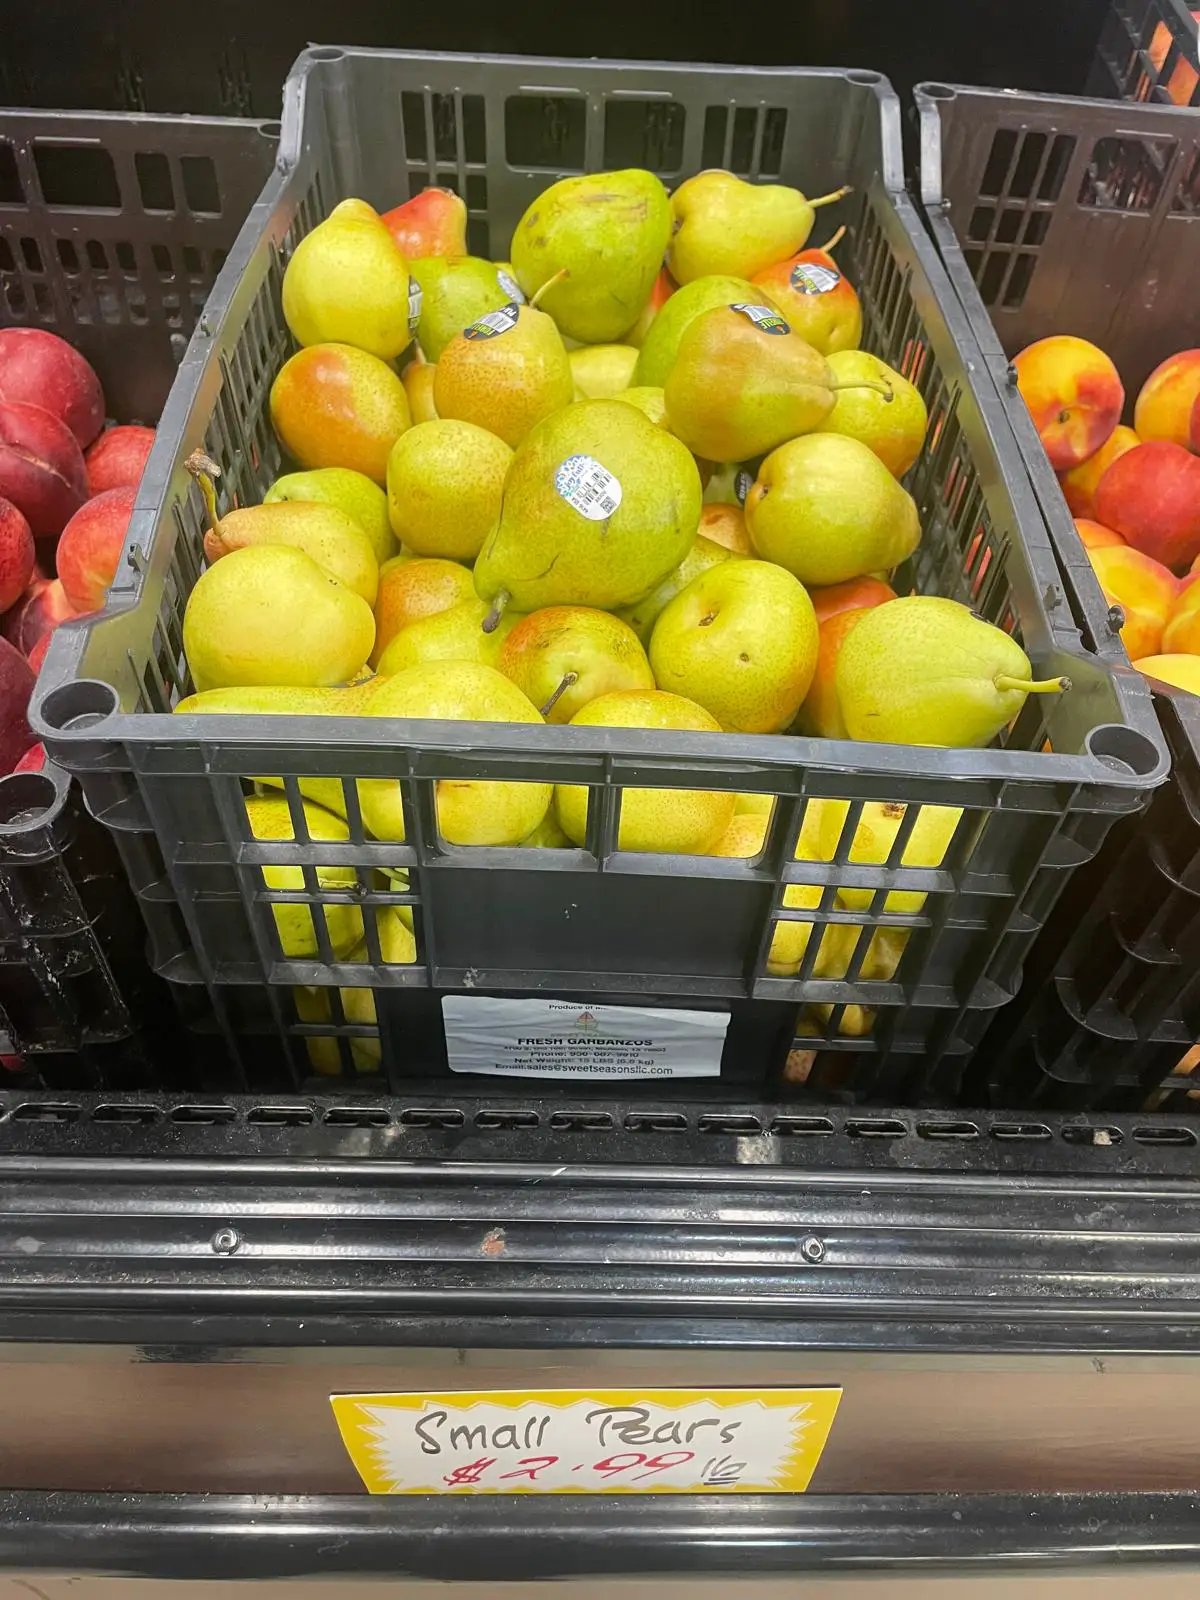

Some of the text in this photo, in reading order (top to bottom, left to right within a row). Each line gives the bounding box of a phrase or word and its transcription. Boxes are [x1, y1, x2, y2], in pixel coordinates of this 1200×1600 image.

[568, 1038, 653, 1046] GARBANZOS
[414, 1405, 743, 1455] Small Pears
